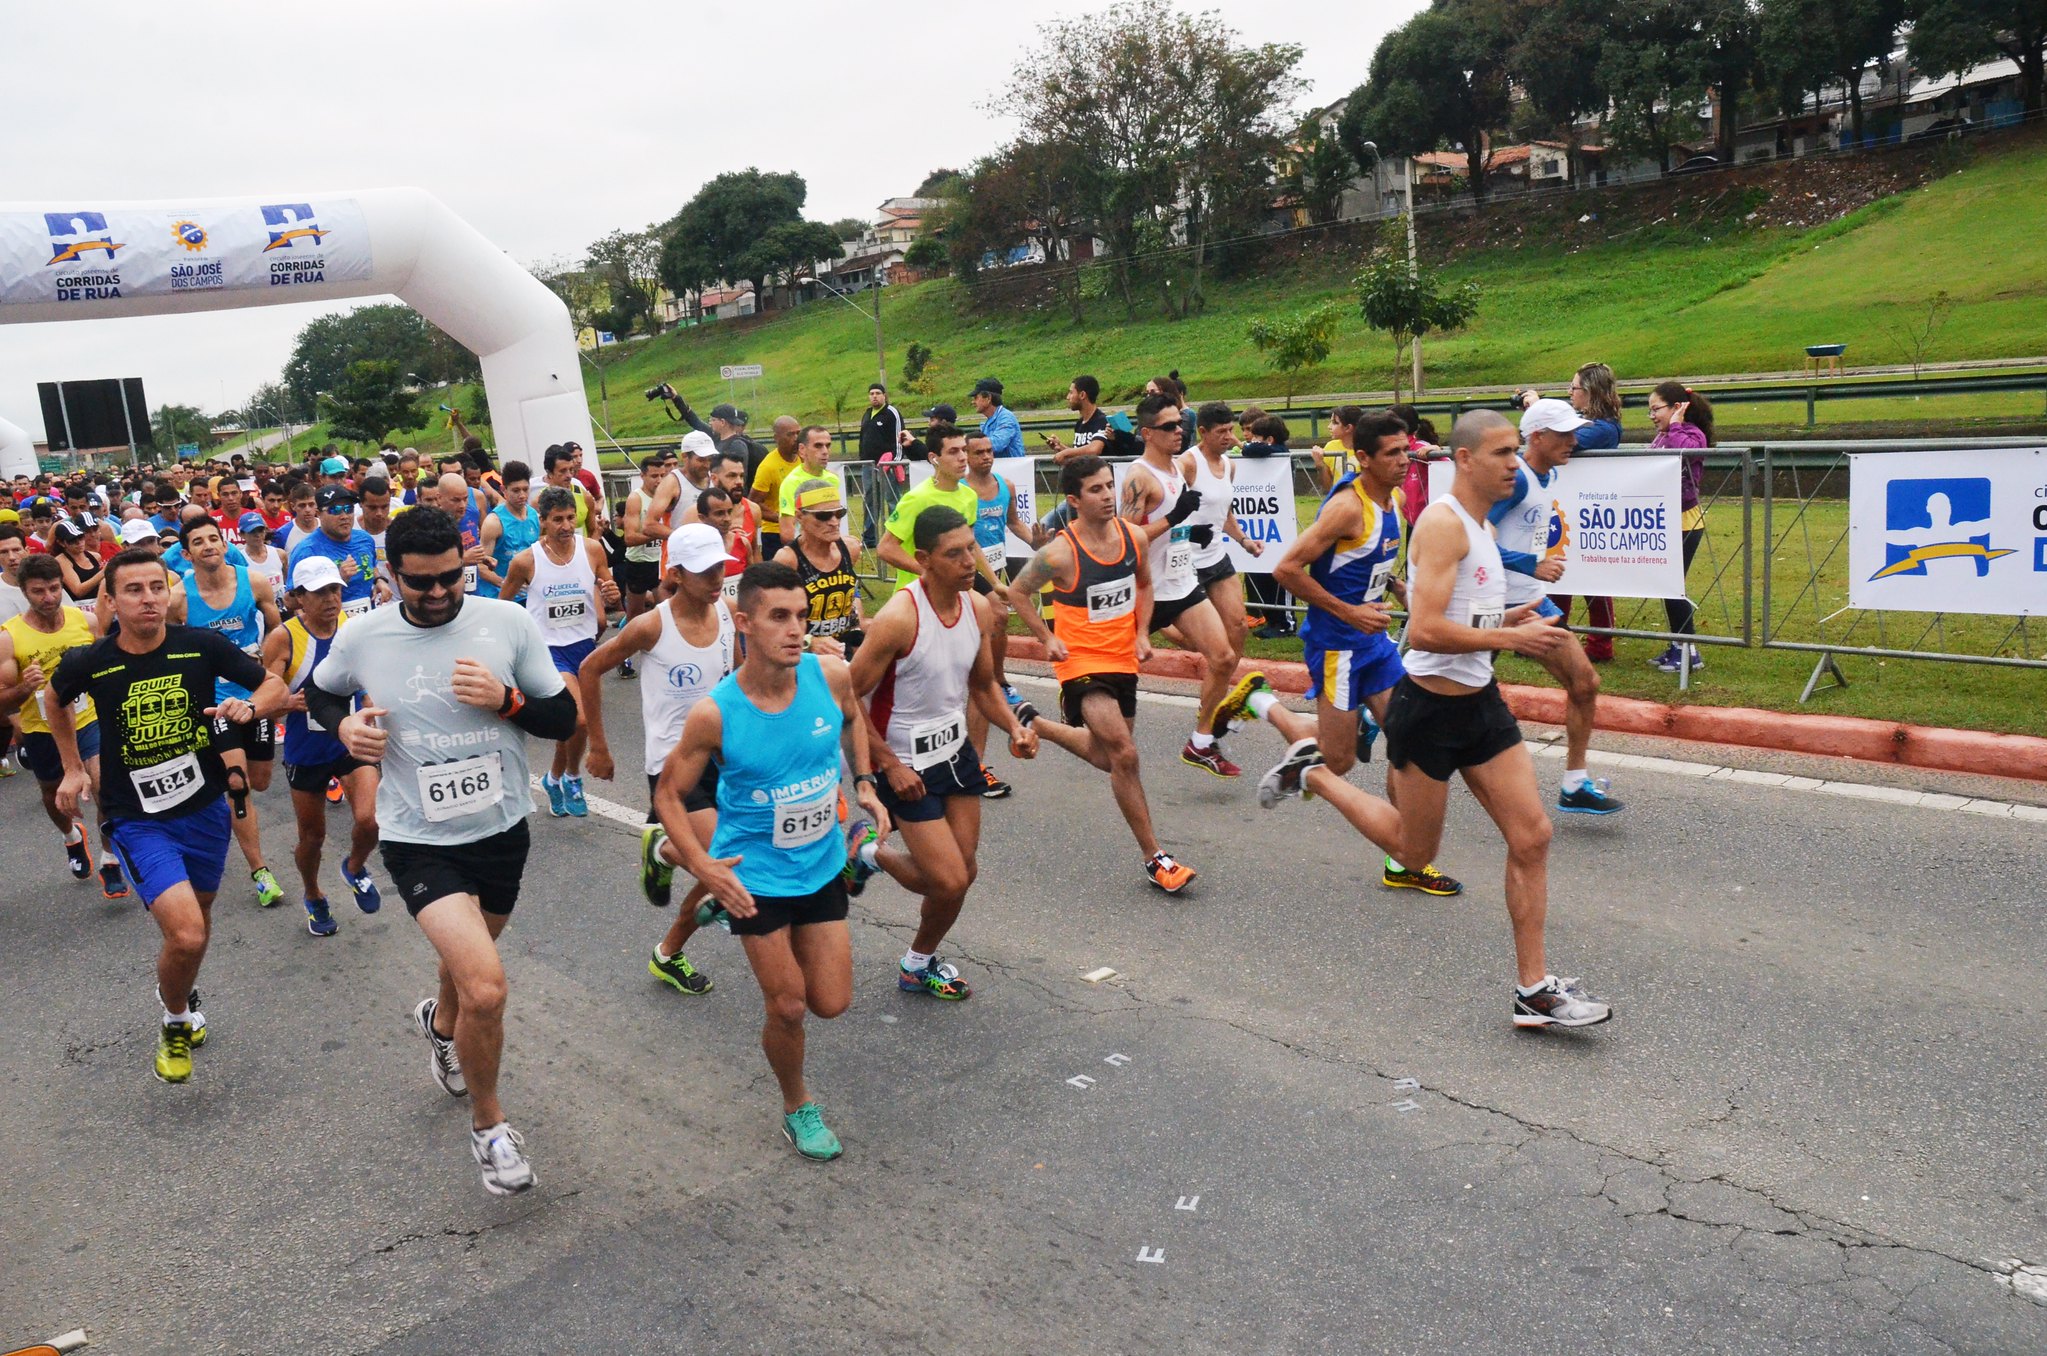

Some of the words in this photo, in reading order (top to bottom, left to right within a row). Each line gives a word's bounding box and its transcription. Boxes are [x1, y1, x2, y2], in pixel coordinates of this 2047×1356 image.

[171, 263, 194, 278] SÃO
[196, 260, 223, 276] JOSÉ
[270, 260, 325, 273] CORRIDAS
[56, 275, 121, 288] CORRIDAS
[171, 279, 189, 289] DOS
[190, 275, 224, 287] CAMPOS
[271, 274, 291, 286] DE
[294, 271, 325, 284] RUA
[57, 288, 81, 301] DE
[85, 287, 122, 300] RUA
[1265, 483, 1276, 493] de
[1579, 492, 1609, 500] Prefeitura
[1231, 497, 1280, 515] RIDAS
[1579, 503, 1616, 530] SÃO
[1620, 502, 1666, 530] JOSÉ
[1580, 532, 1606, 550] DOS
[1610, 532, 1667, 551] CAMPOS
[1581, 554, 1608, 563] Trabalho
[1608, 556, 1620, 564] que
[1637, 556, 1667, 564] diferença
[805, 570, 855, 594] EQUIPE
[1098, 590, 1128, 609] 274
[554, 604, 581, 618] 025
[209, 616, 242, 629] BRASAS
[131, 676, 180, 694] EQUIPE
[122, 687, 189, 727] 100
[130, 716, 192, 745] JUÍZO
[423, 726, 501, 749] Tenaris
[923, 727, 954, 752] 100
[123, 753, 165, 766] CORRENDO
[149, 769, 189, 796] 184
[429, 772, 490, 803] 6168
